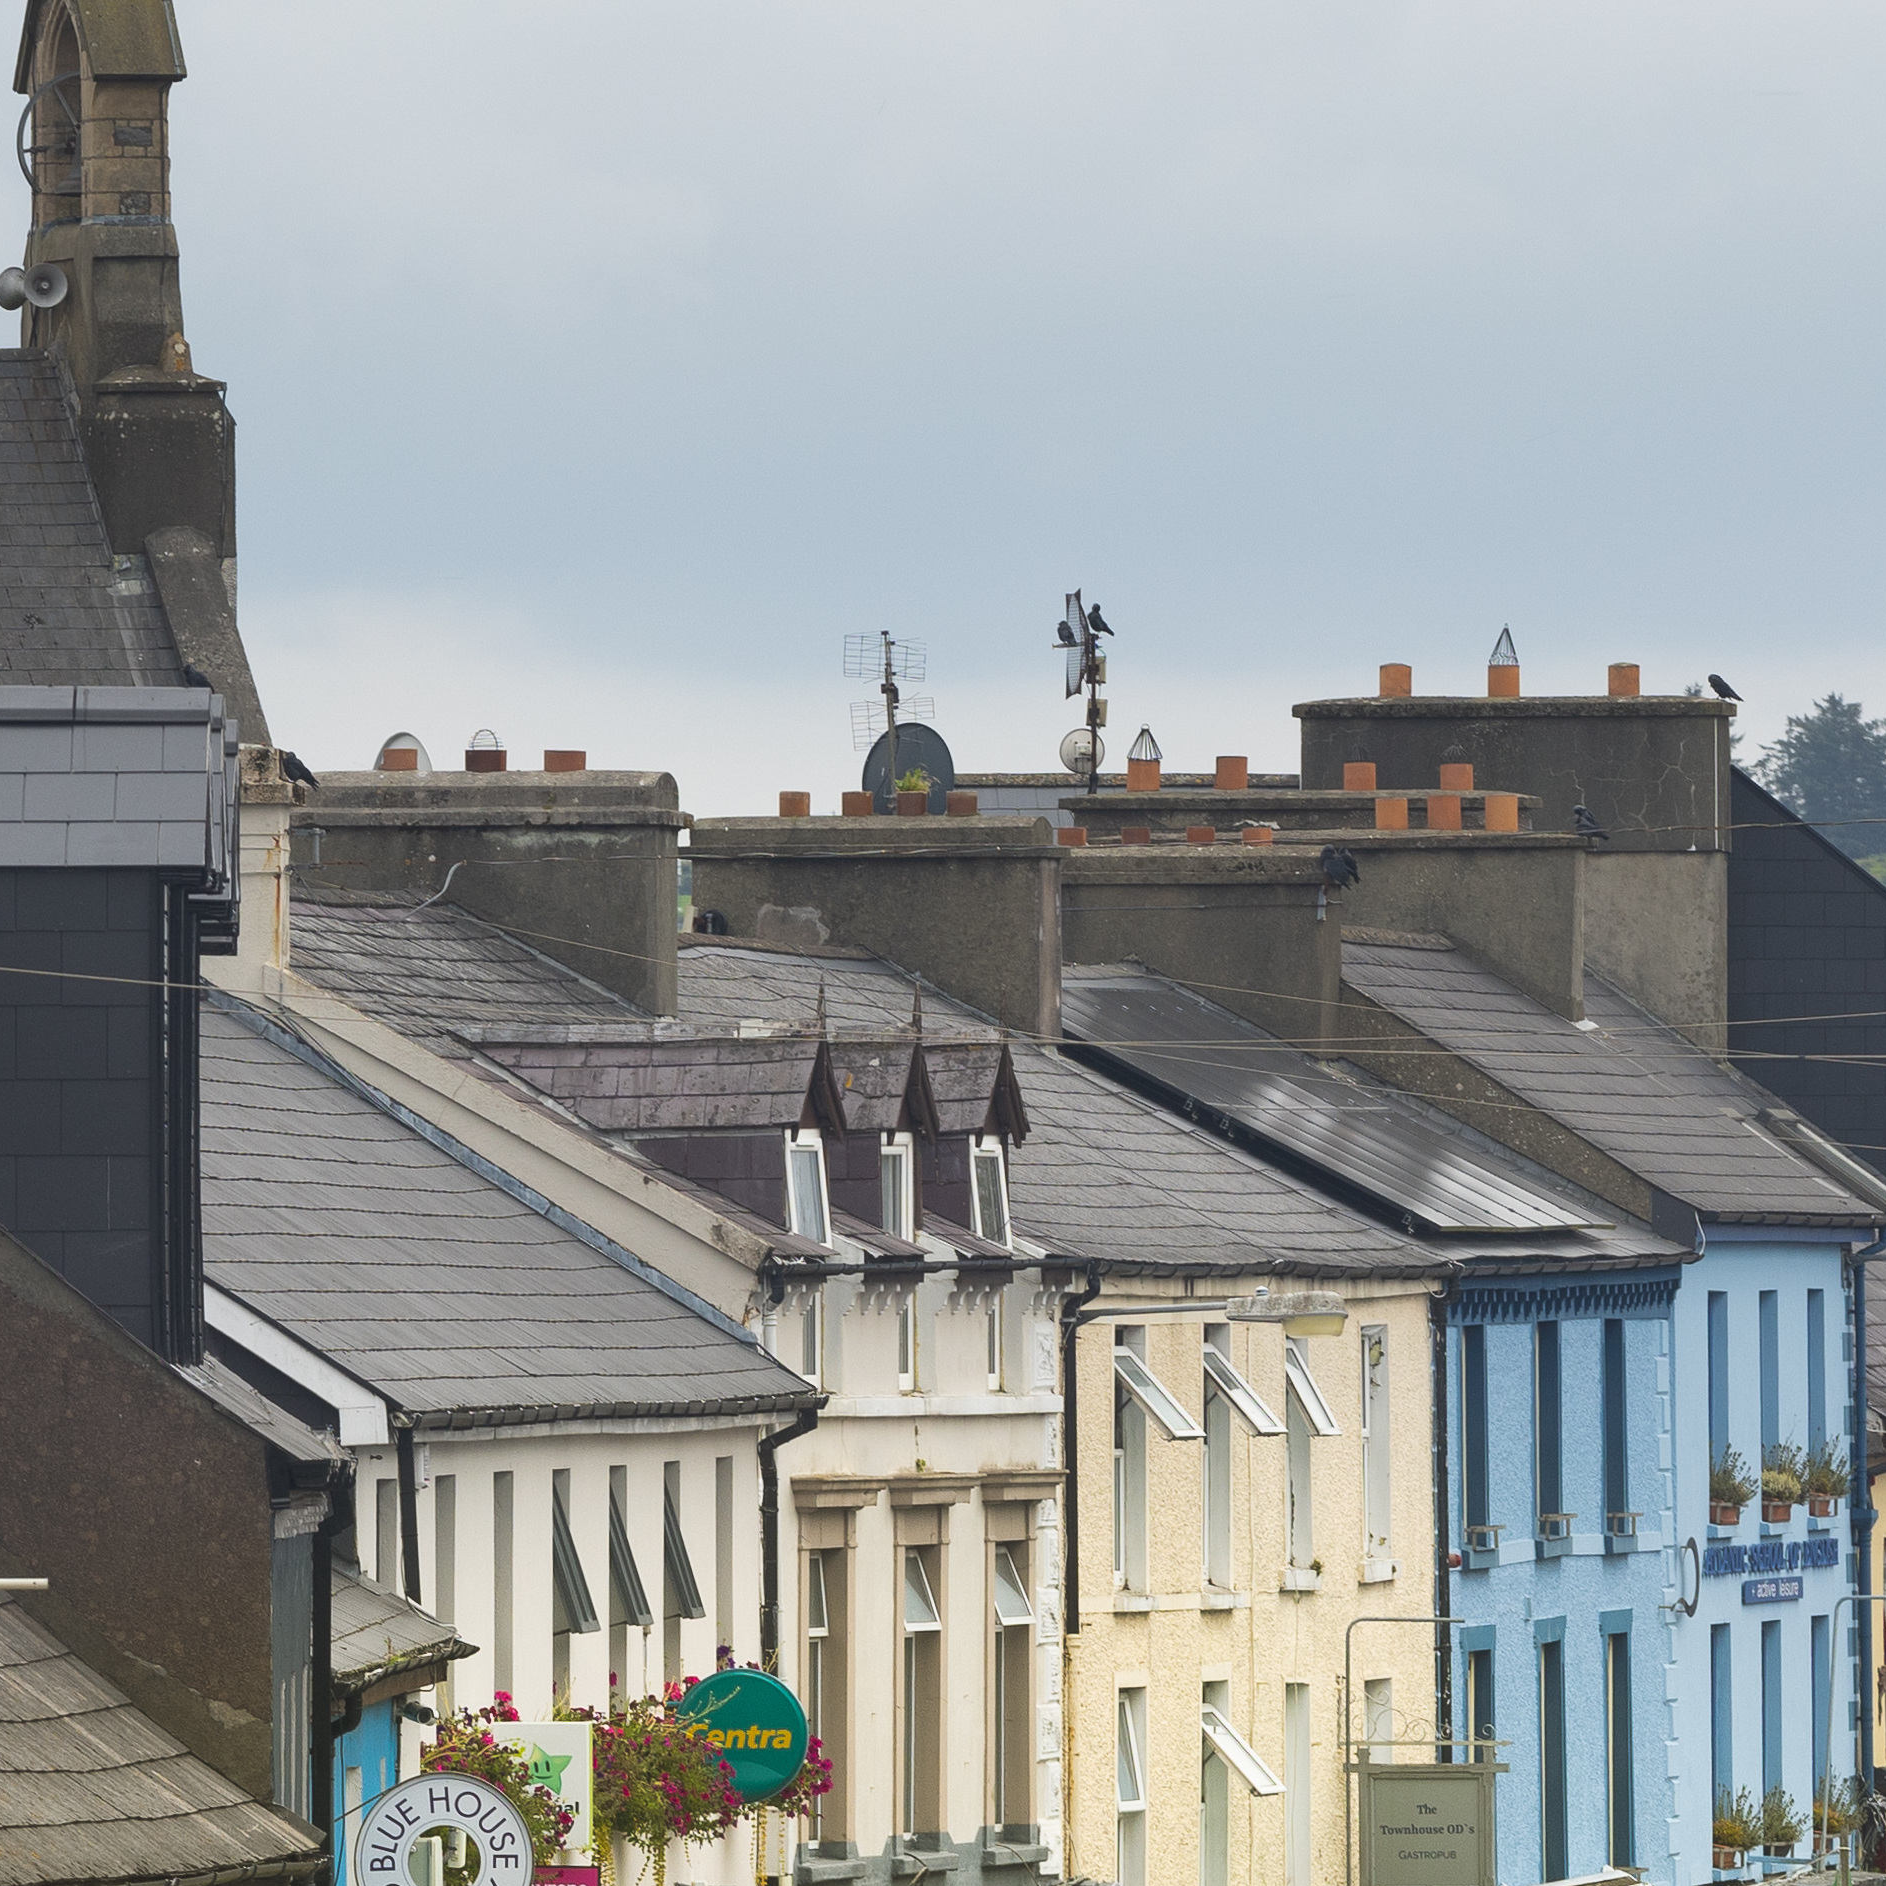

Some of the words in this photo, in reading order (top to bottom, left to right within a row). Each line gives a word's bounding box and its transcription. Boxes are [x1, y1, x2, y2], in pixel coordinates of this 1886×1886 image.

[1417, 1804, 1437, 1814] The
[370, 1798, 421, 1872] BLUE
[428, 1786, 519, 1869] HOUSE
[1380, 1824, 1444, 1835] Townhouse
[1398, 1850, 1457, 1860] GASTROPUB
